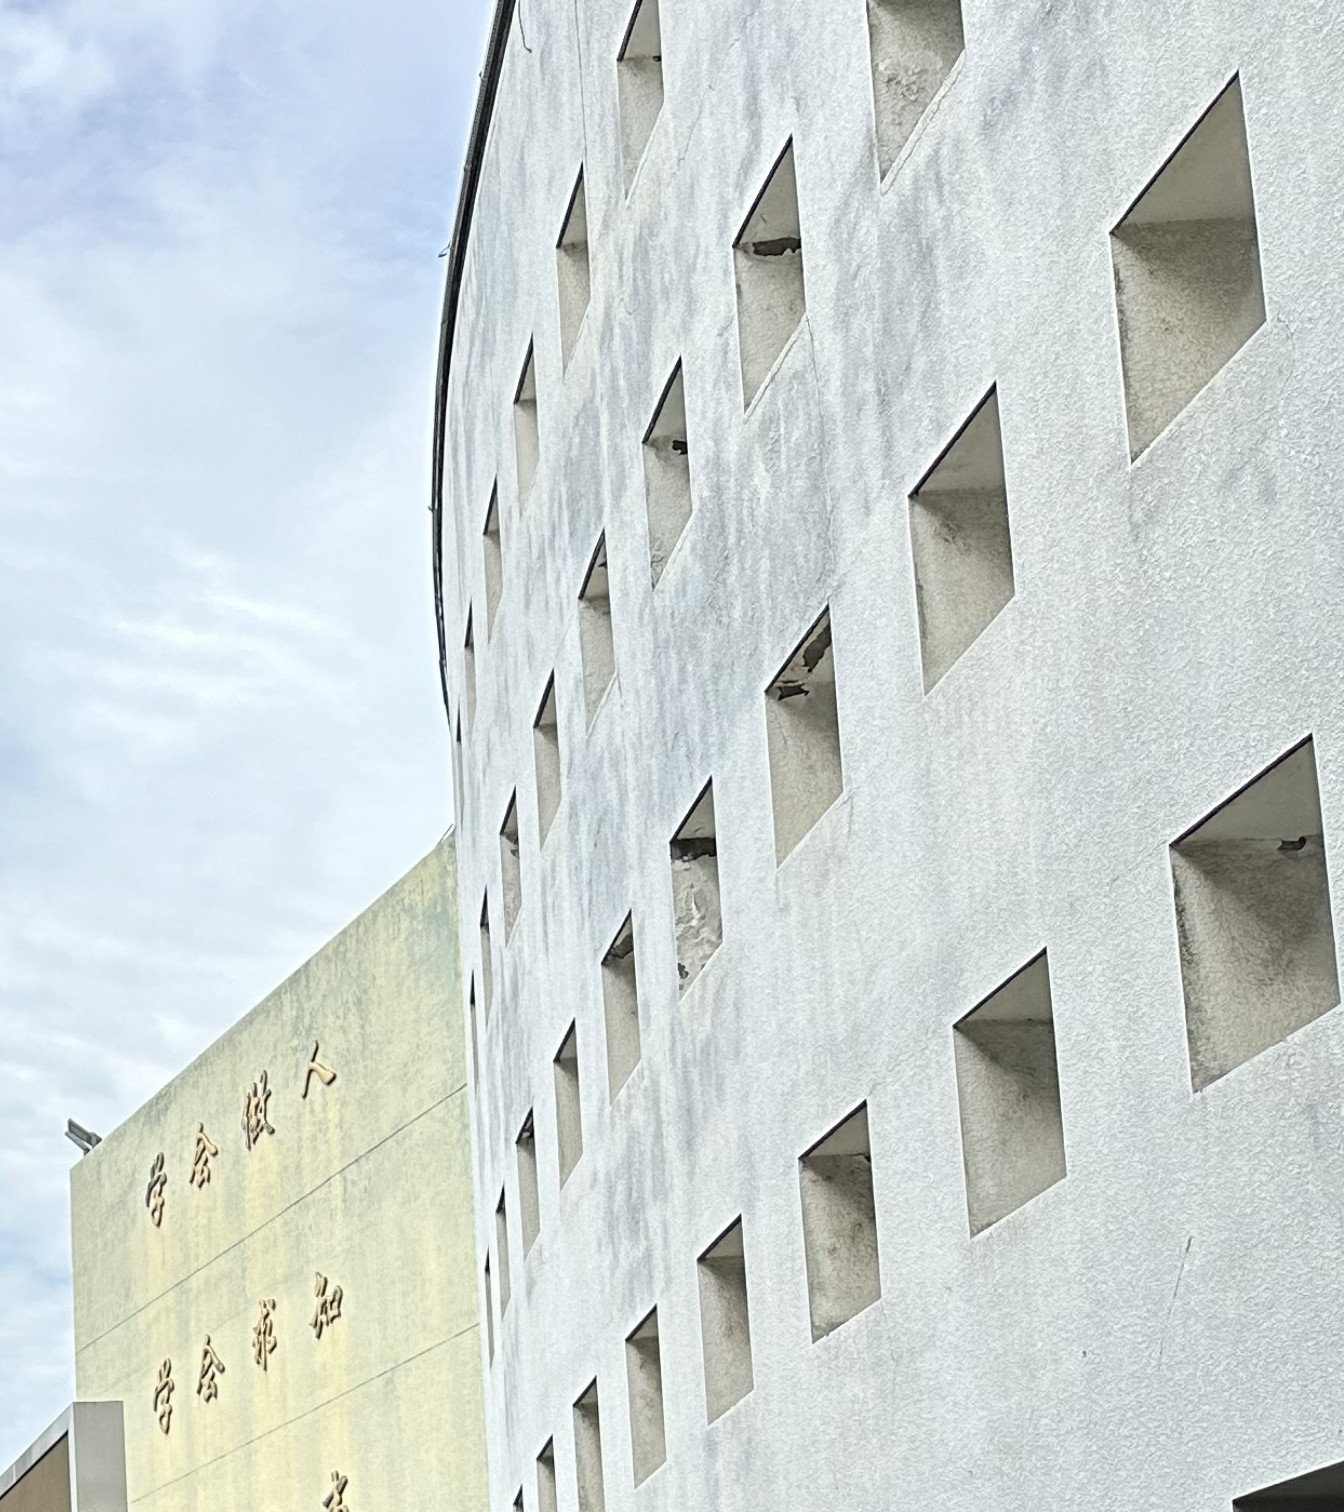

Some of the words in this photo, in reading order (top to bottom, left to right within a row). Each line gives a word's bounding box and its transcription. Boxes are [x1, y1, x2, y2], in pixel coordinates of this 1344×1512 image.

[145, 1040, 337, 1228] 学会做人
[153, 1271, 345, 1436] 学会求知
